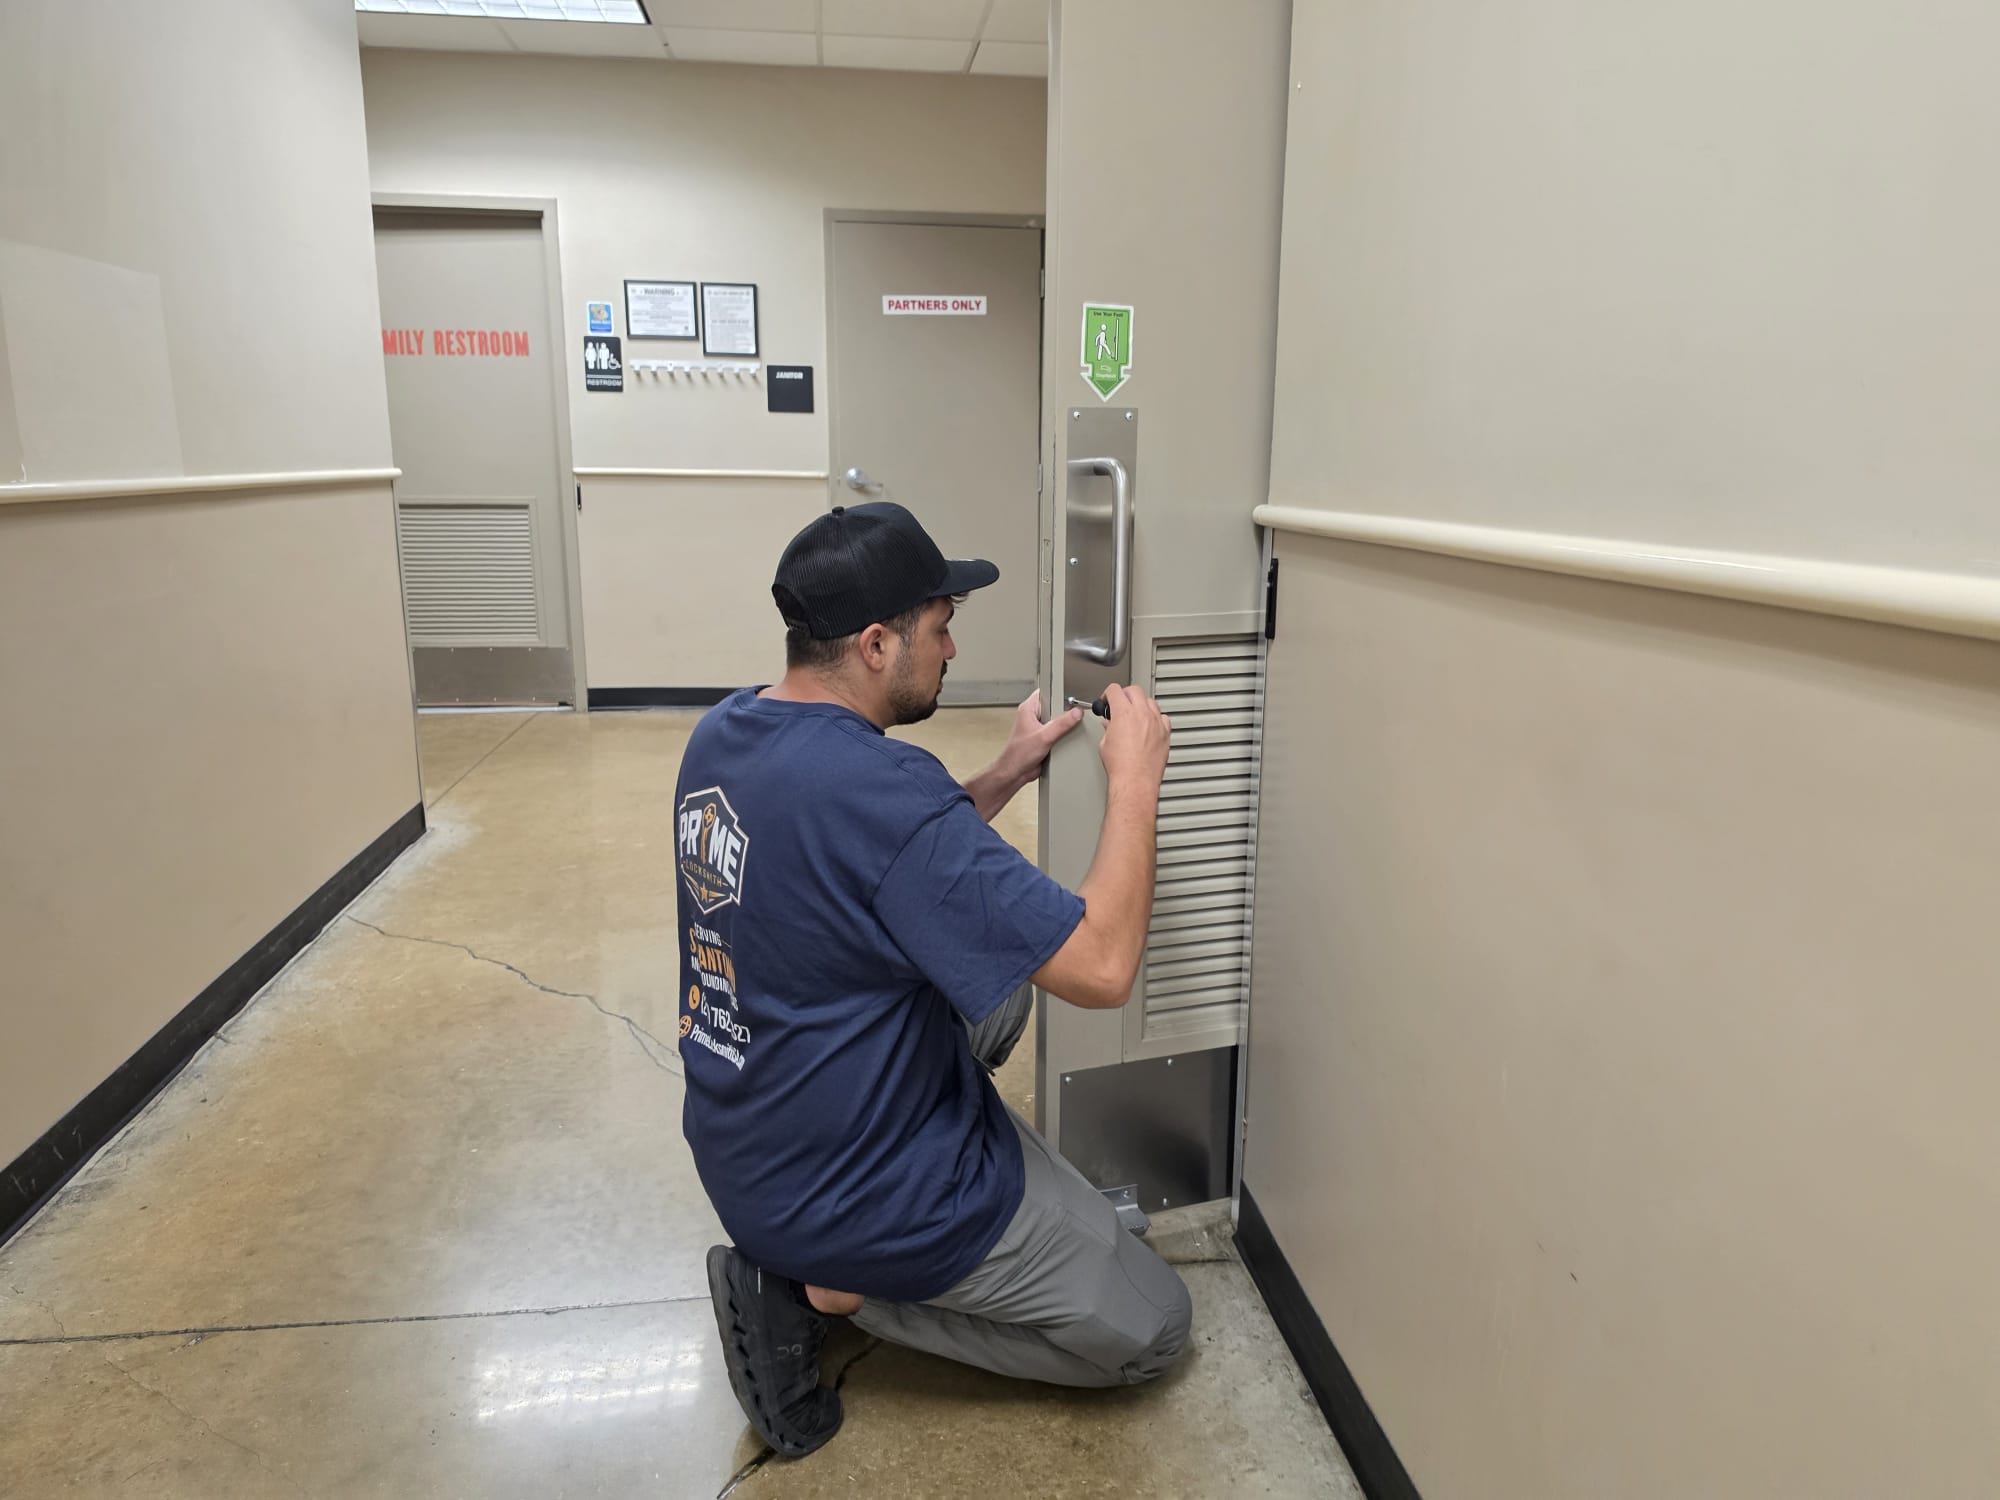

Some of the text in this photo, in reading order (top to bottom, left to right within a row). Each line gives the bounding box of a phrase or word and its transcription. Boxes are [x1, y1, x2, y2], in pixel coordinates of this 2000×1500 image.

[887, 299, 982, 311] PARTNERS ONLY
[382, 329, 529, 357] MILY RESTROOM
[586, 378, 622, 387] RESTROOM
